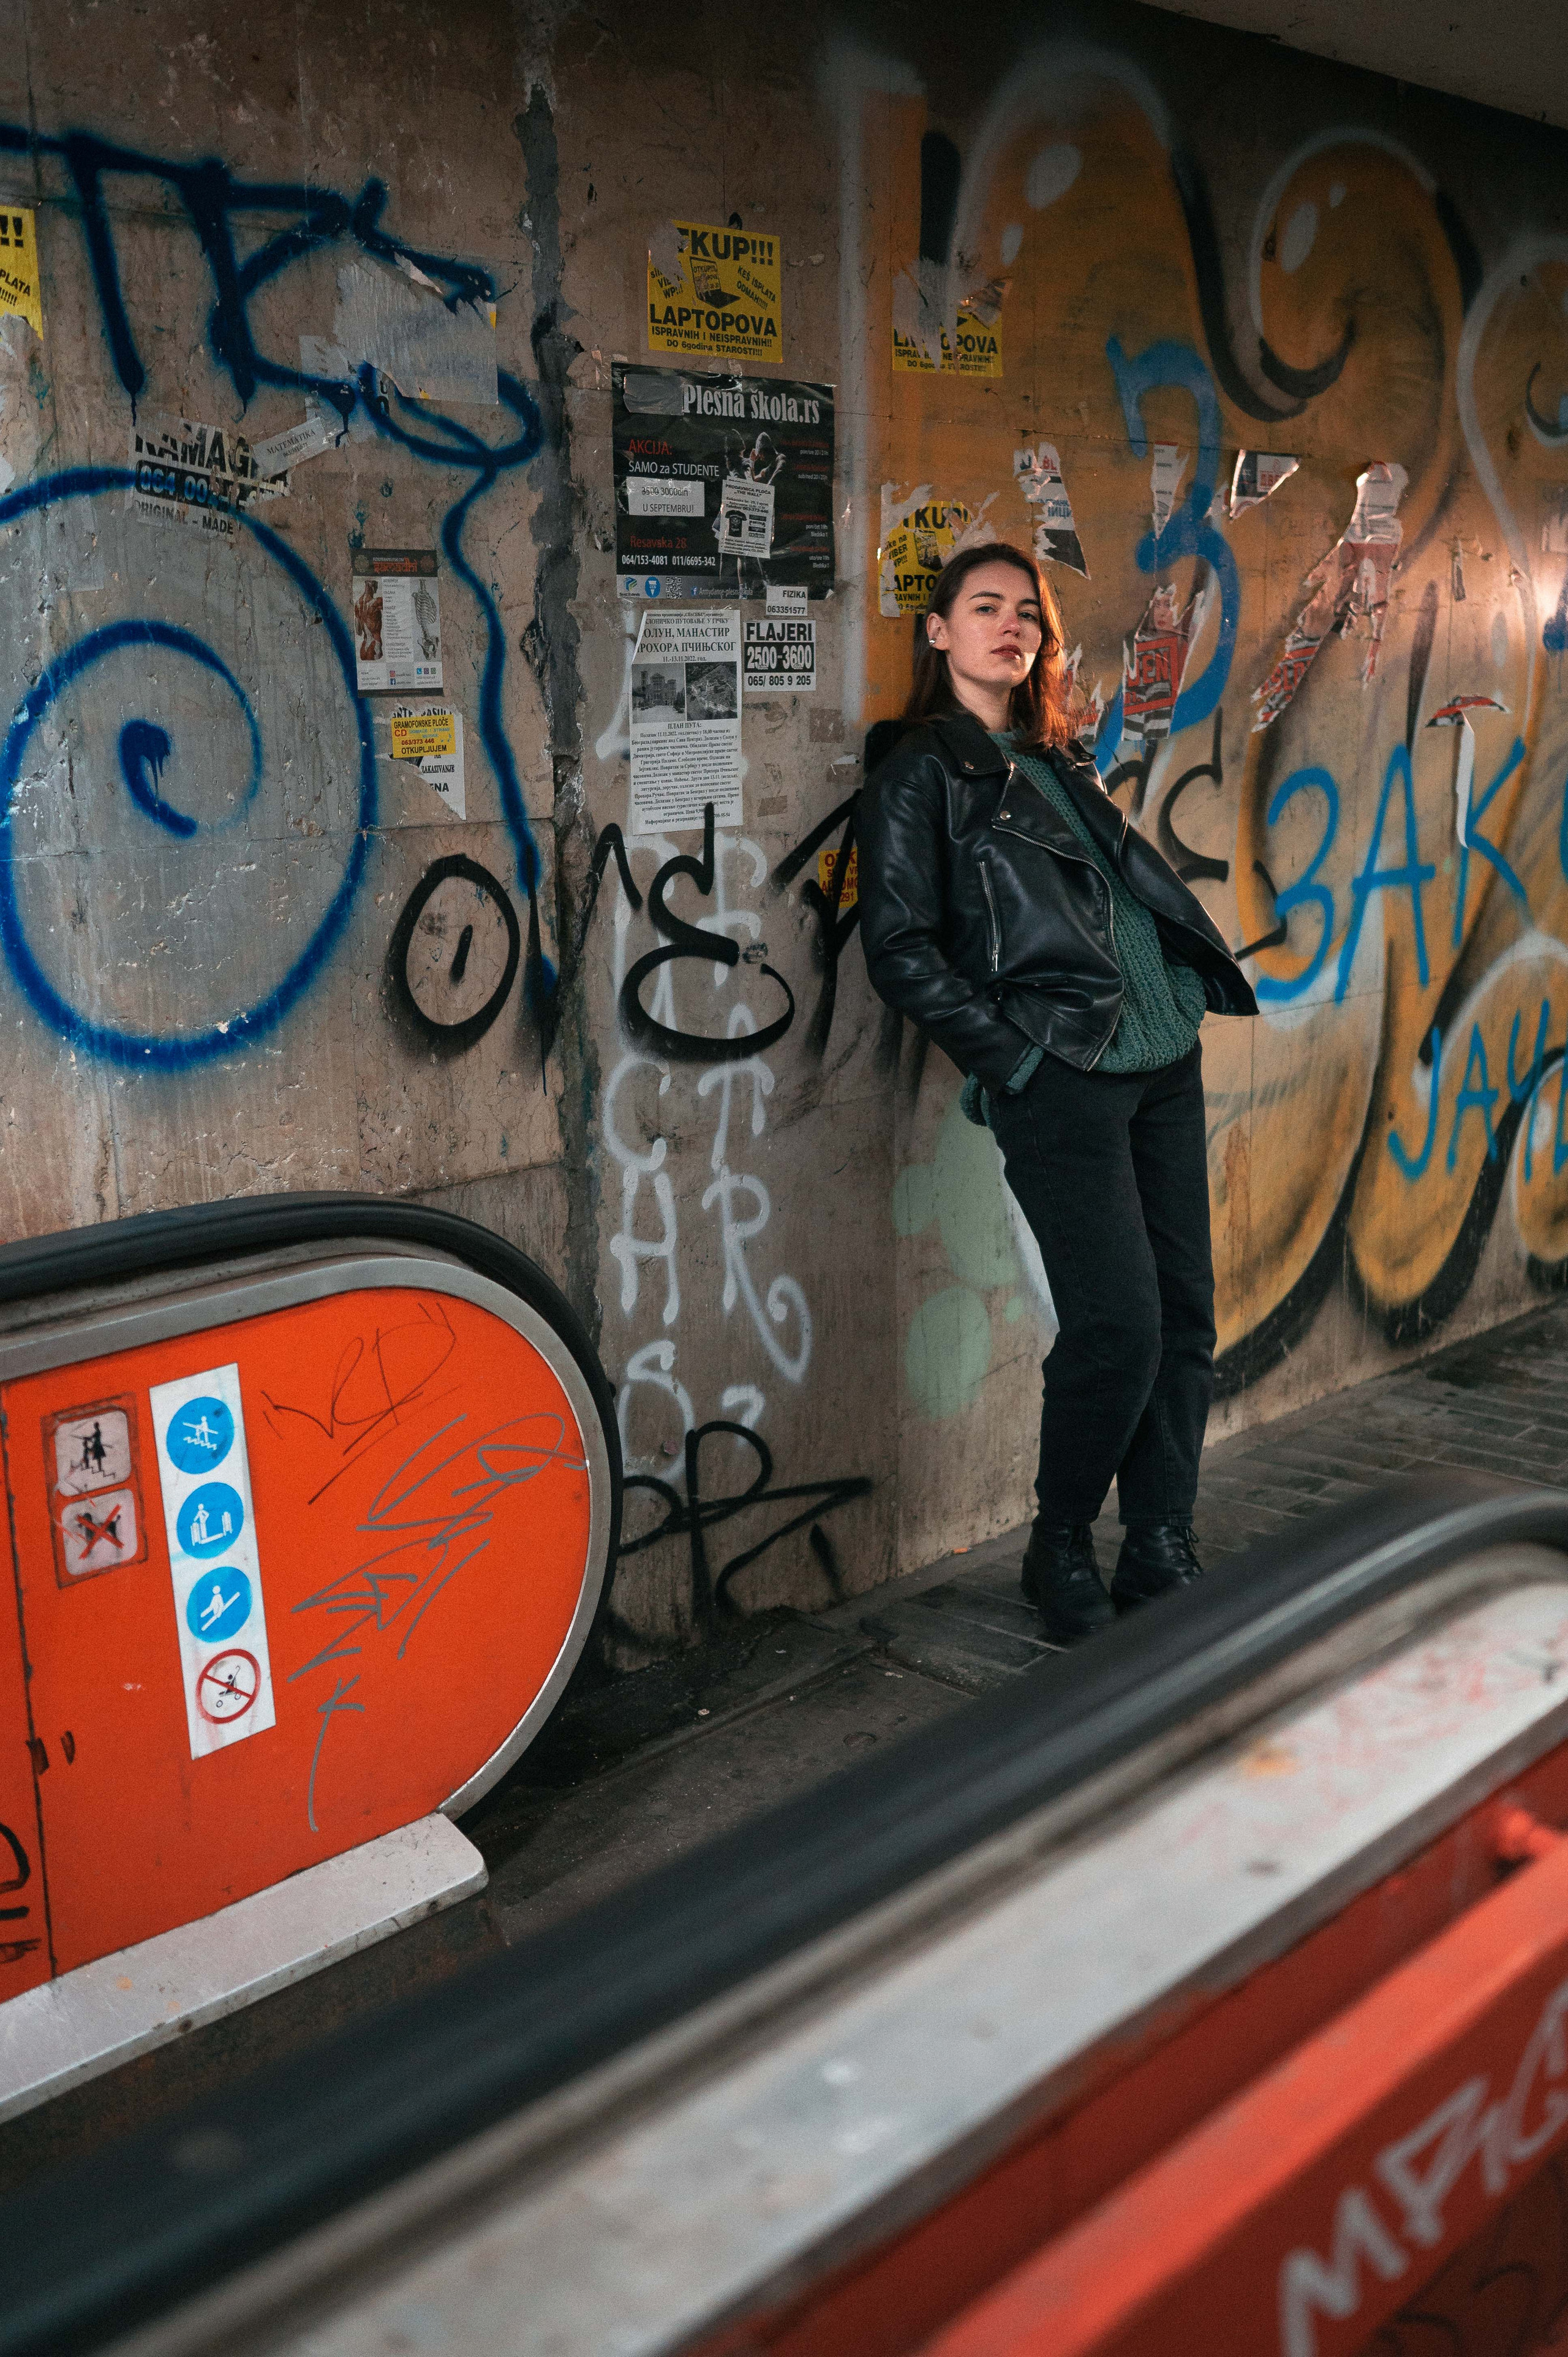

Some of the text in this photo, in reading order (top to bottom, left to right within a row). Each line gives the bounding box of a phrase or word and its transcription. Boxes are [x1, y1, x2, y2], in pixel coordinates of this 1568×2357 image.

[737, 266, 750, 282] KEŠ
[752, 277, 776, 304] ISPLATA
[650, 304, 777, 337] LAPTOPOVA
[652, 326, 699, 339] ISPRAVNIH
[667, 339, 679, 347] DO
[682, 341, 713, 352] 6godina
[683, 384, 820, 424] Plesna škola.rs
[266, 429, 316, 456] MATEMATIKA
[629, 438, 672, 455] AKCIJA:
[628, 461, 719, 477] SAMO za STUDENTE
[643, 502, 694, 513] U SEPTEMBRU!
[202, 515, 233, 535] MADE
[630, 536, 673, 548] Resavska
[622, 554, 715, 566] 064/153-4081 011/6695-342
[783, 590, 806, 599] FIZIKA
[767, 605, 805, 615] 063351577
[643, 627, 730, 639] ОЛУН, МАНАСТИР
[746, 622, 812, 641] FLAJERI
[682, 642, 736, 652] ПЧИЊСКОГ
[748, 675, 811, 687] 065/ 805 9 205
[394, 716, 448, 728] GRAMOFONSKE PLOČE
[401, 745, 447, 755] OTKUPLJUJEM
[421, 765, 454, 773] ZAKAZIVANJE
